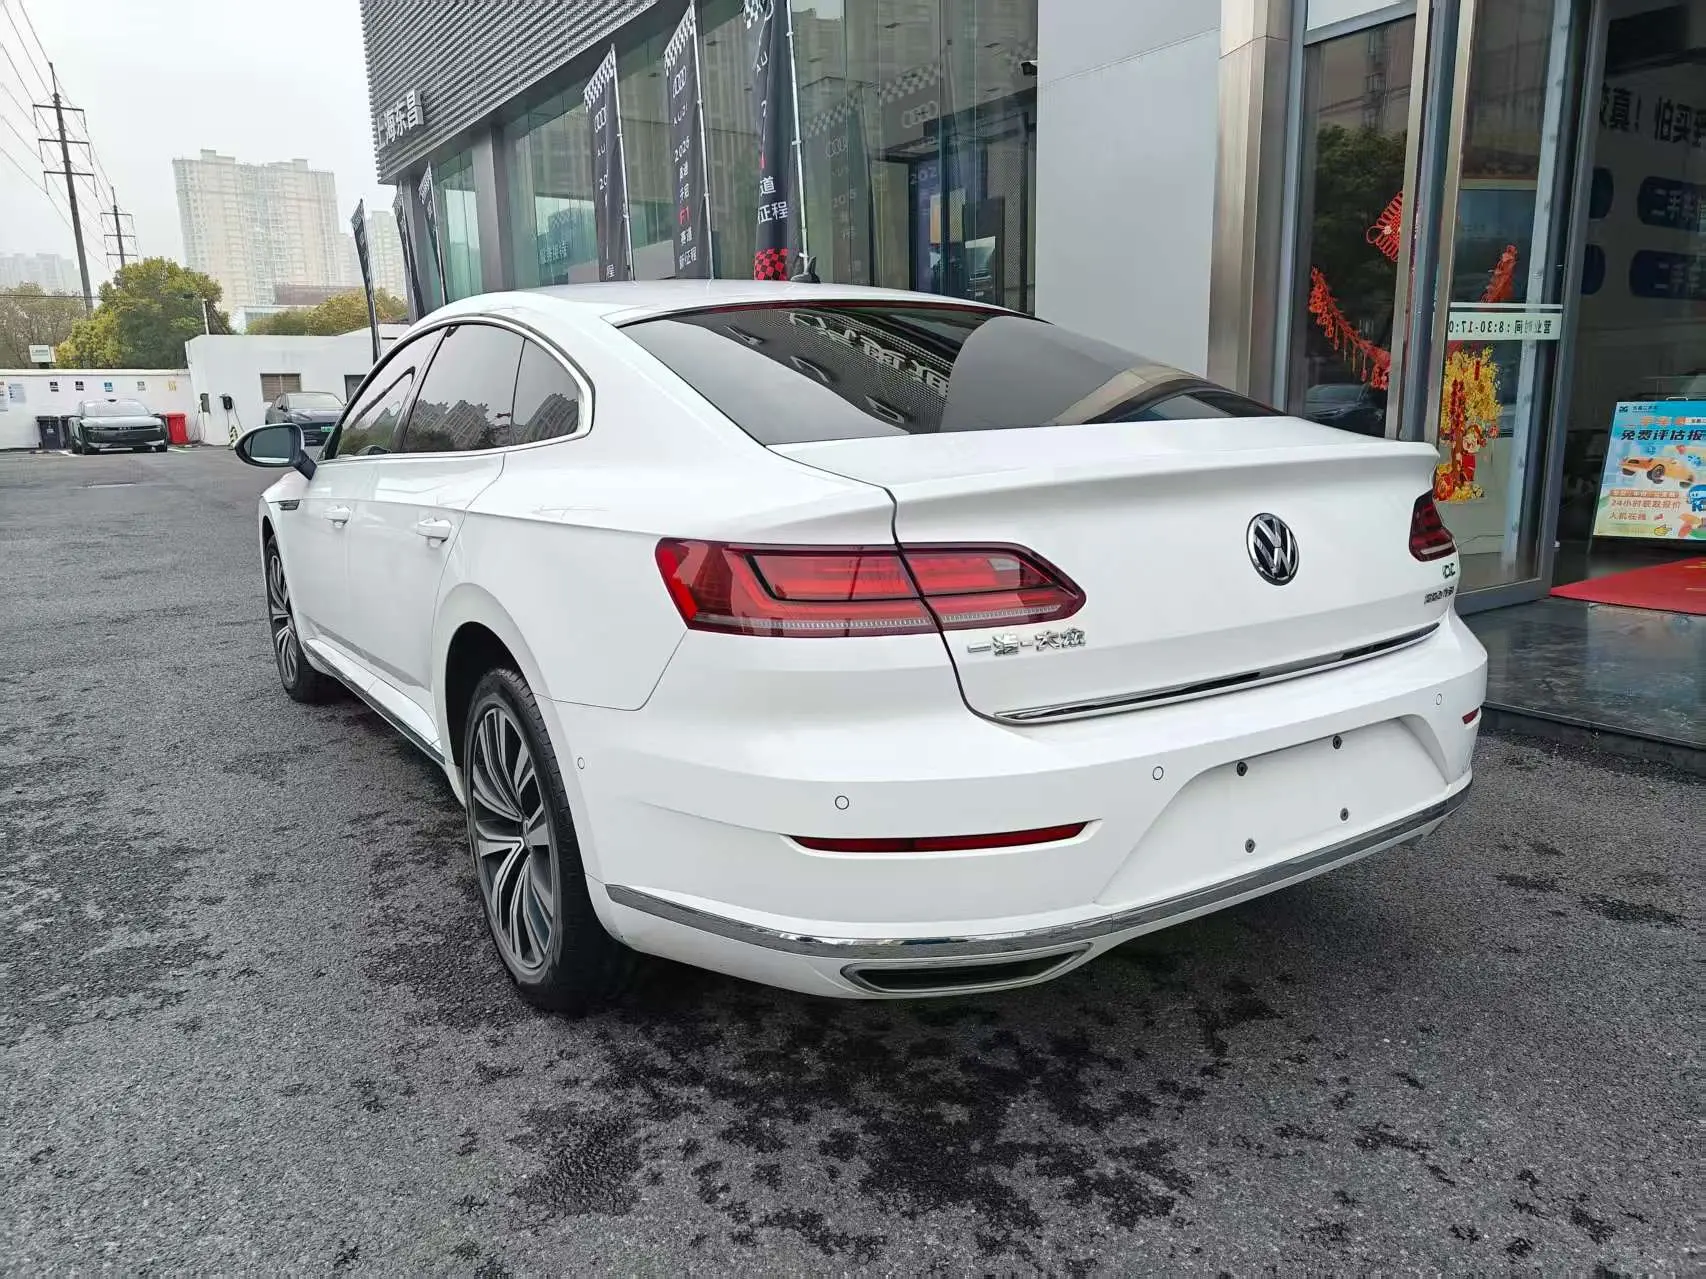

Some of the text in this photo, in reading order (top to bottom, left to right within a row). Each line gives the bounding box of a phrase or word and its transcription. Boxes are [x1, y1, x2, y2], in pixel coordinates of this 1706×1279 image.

[1621, 429, 1706, 441] 免费评估报
[967, 627, 1086, 656] 一汽-大众
